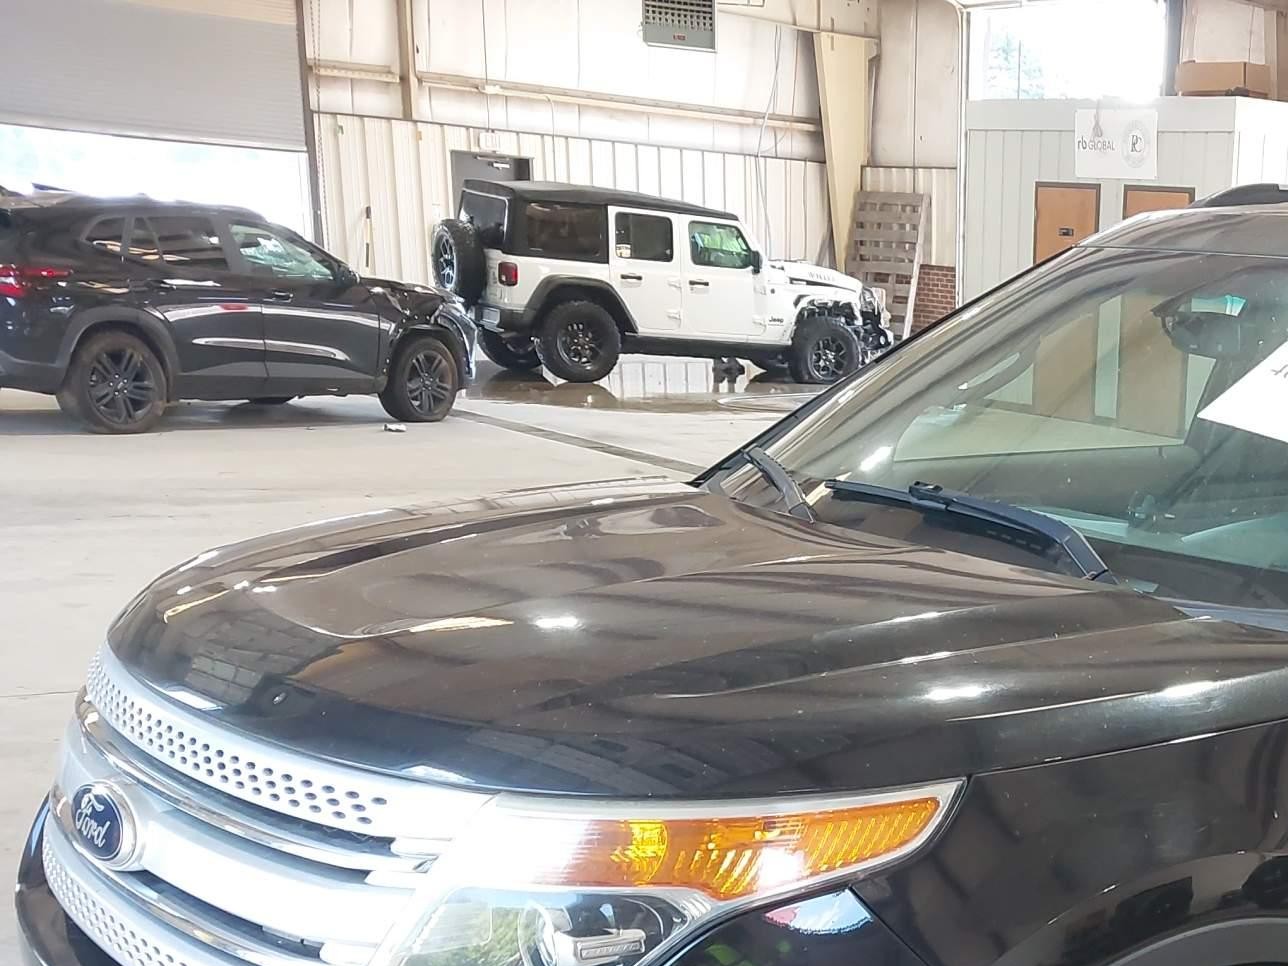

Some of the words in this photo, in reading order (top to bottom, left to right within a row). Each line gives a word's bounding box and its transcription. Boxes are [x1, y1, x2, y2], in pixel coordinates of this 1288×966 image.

[1088, 140, 1116, 151] GLOBAL
[768, 316, 785, 324] Jeep
[75, 792, 111, 848] Ford
